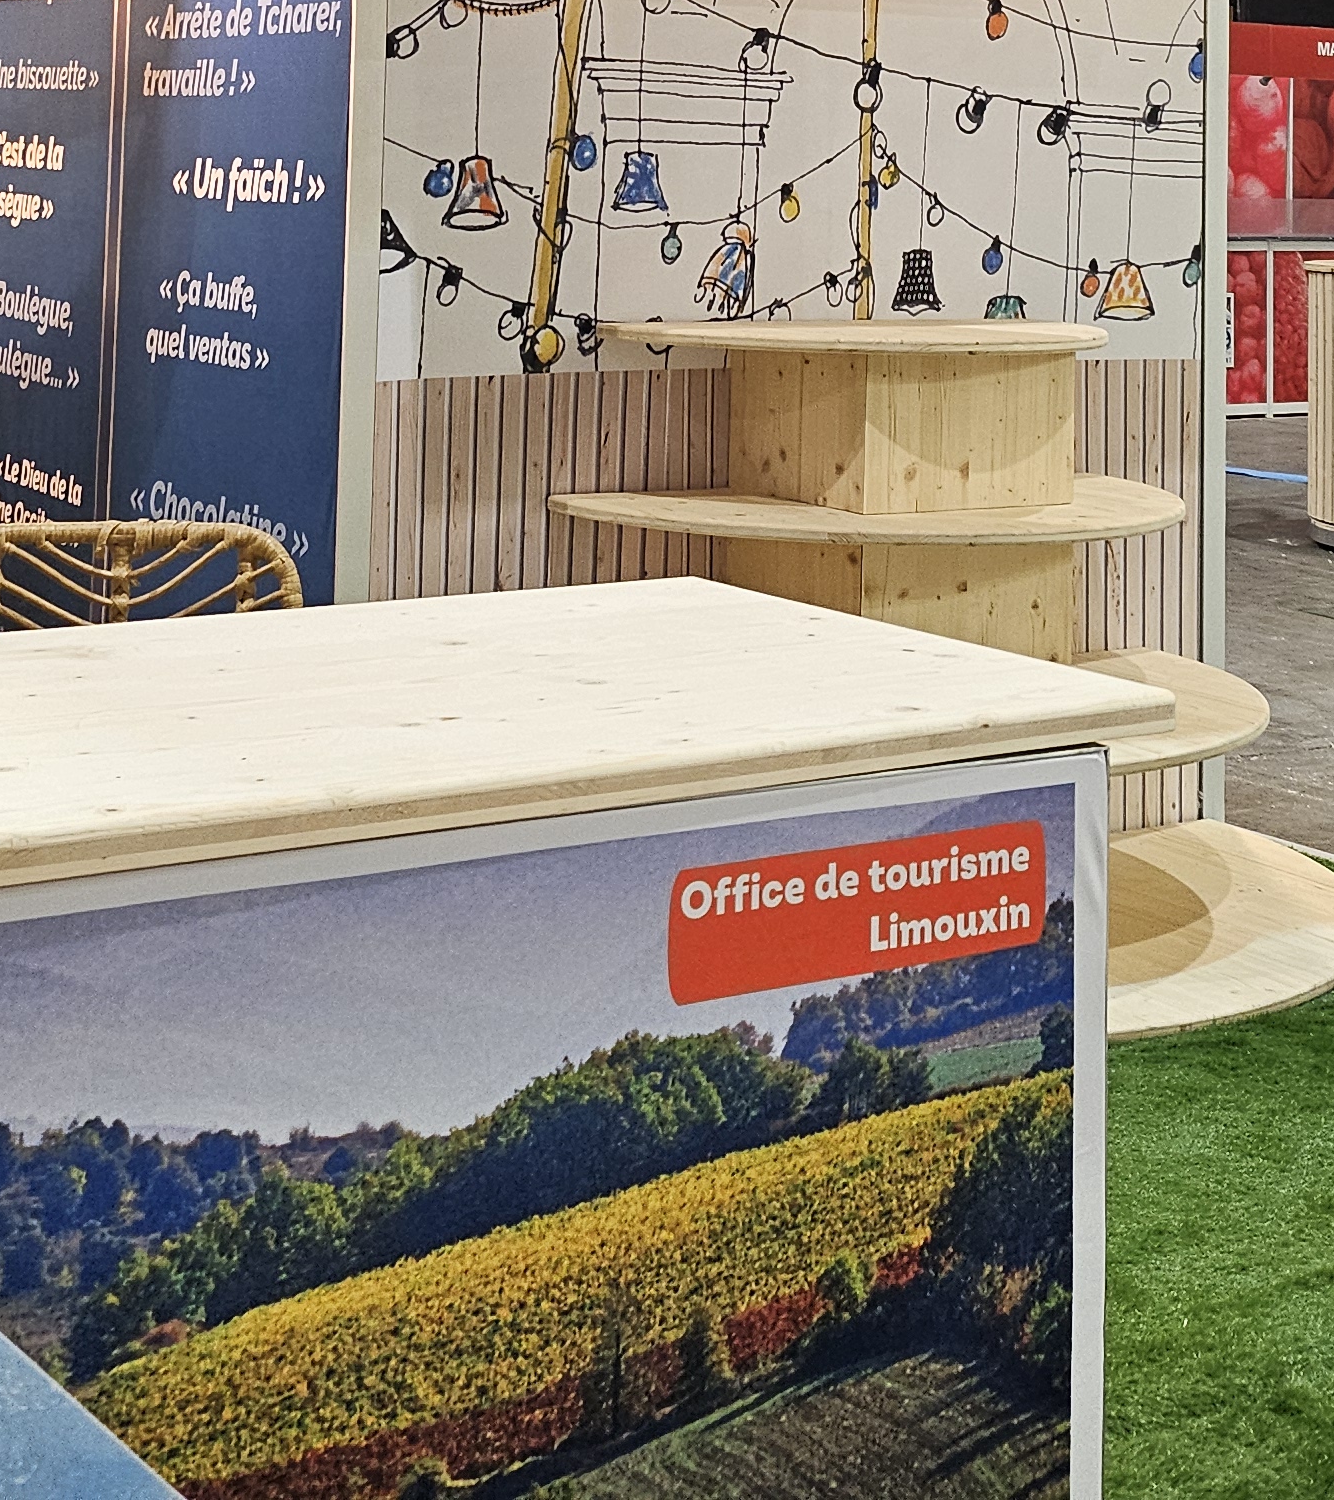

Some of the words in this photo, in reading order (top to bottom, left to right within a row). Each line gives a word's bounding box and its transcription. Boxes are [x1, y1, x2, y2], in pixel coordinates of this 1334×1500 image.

[160, 1, 223, 40] Arrête
[225, 0, 253, 36] de
[16, 58, 88, 91] biscouette
[142, 60, 227, 98] travaille
[25, 133, 45, 169] de
[46, 134, 64, 172] la
[193, 158, 225, 200] Un
[227, 157, 288, 212] faïch
[176, 270, 202, 313] Ça
[203, 272, 258, 319] buffe,
[145, 324, 187, 364] quel
[187, 333, 253, 371] ventas
[4, 453, 20, 483] Le
[20, 459, 49, 496] Dieu
[50, 469, 67, 501] de
[68, 475, 83, 507] la
[681, 870, 805, 920] Office
[815, 862, 859, 901] de
[867, 845, 1030, 894] tourisme
[870, 896, 1030, 953] Limouxin
